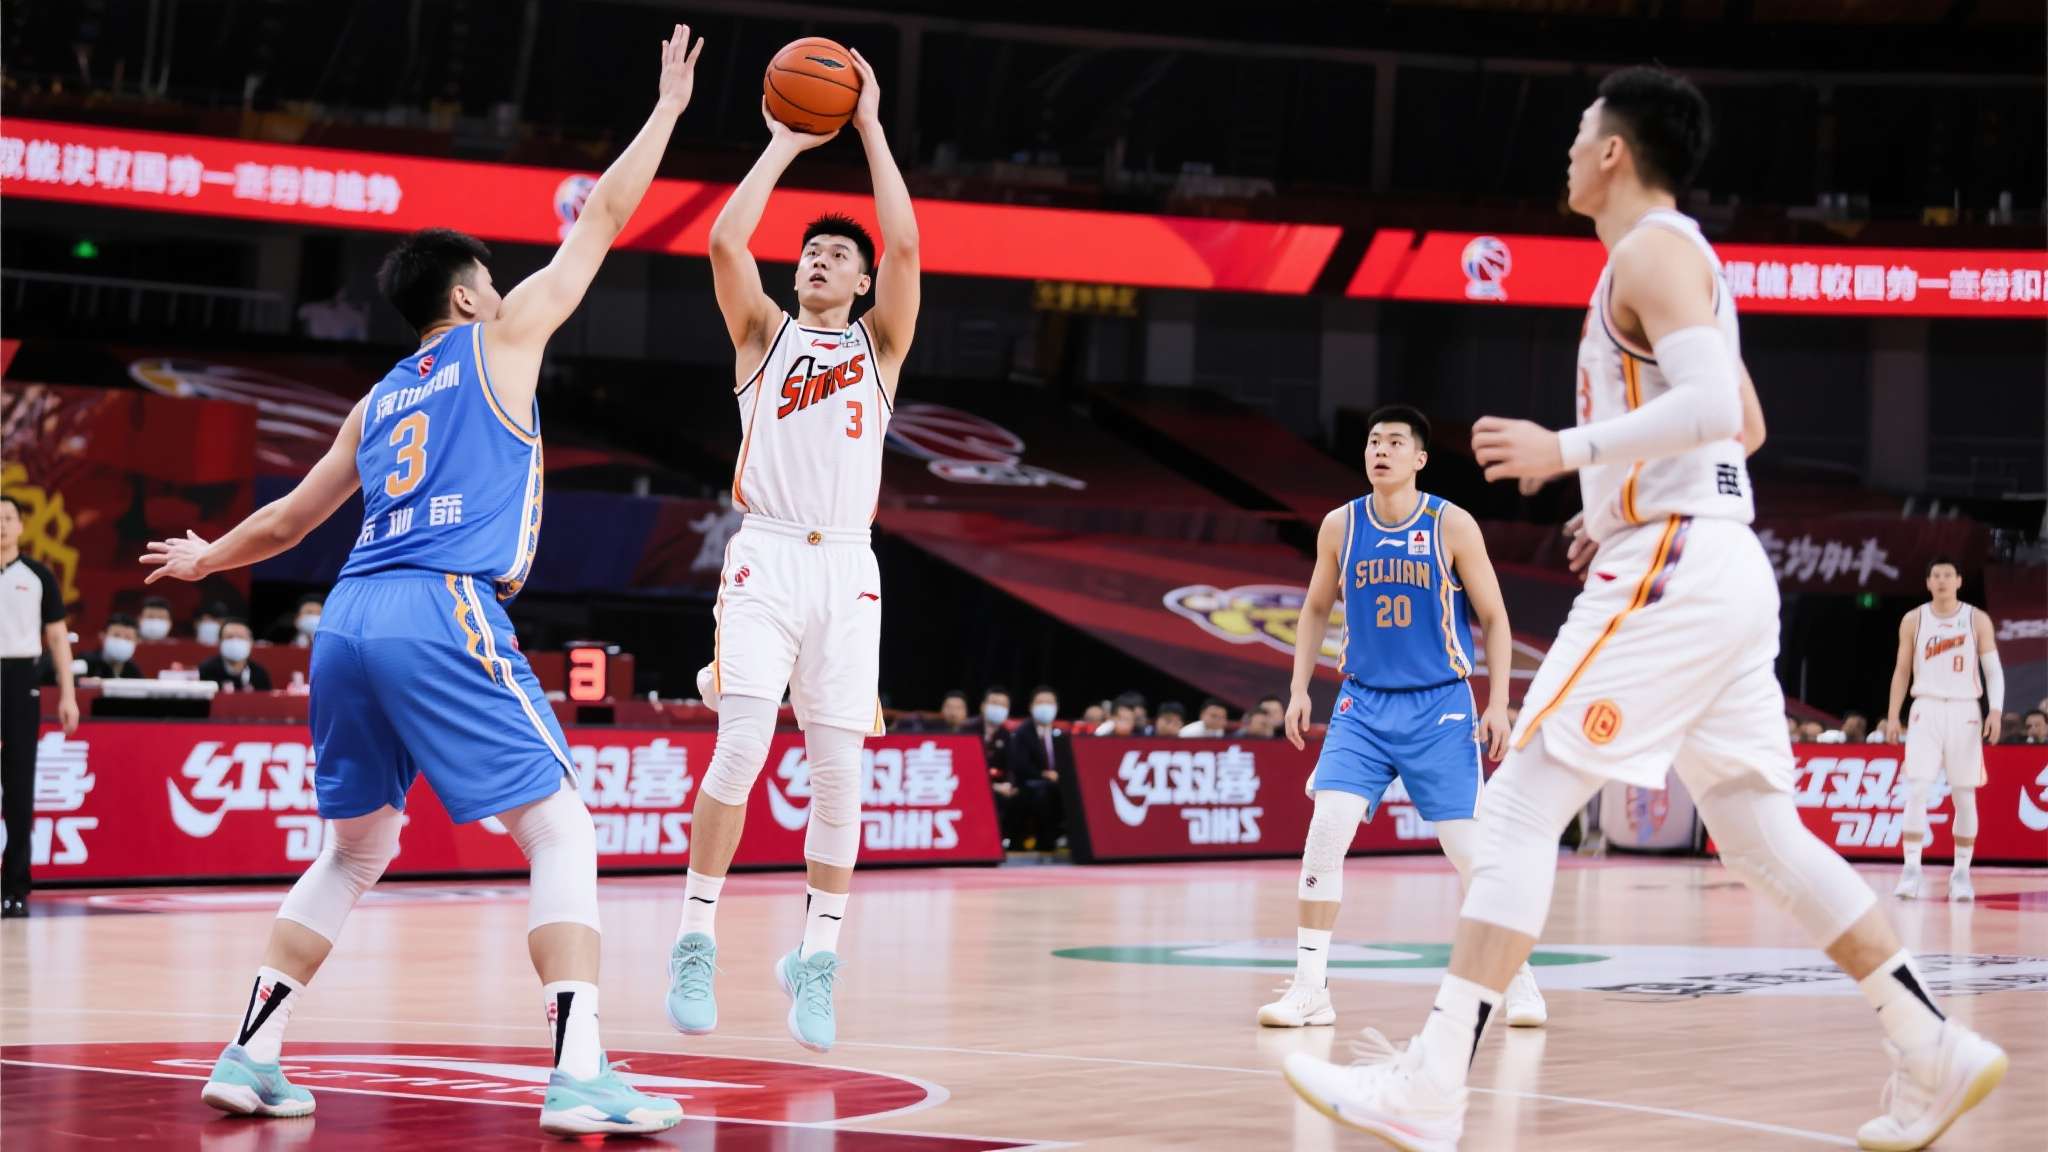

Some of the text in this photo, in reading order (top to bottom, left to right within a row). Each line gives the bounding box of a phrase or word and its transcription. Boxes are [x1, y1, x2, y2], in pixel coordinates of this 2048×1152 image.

[846, 401, 863, 439] 3
[384, 411, 430, 499] 3
[1376, 594, 1412, 628] 20
[1118, 744, 1261, 805] 红双喜
